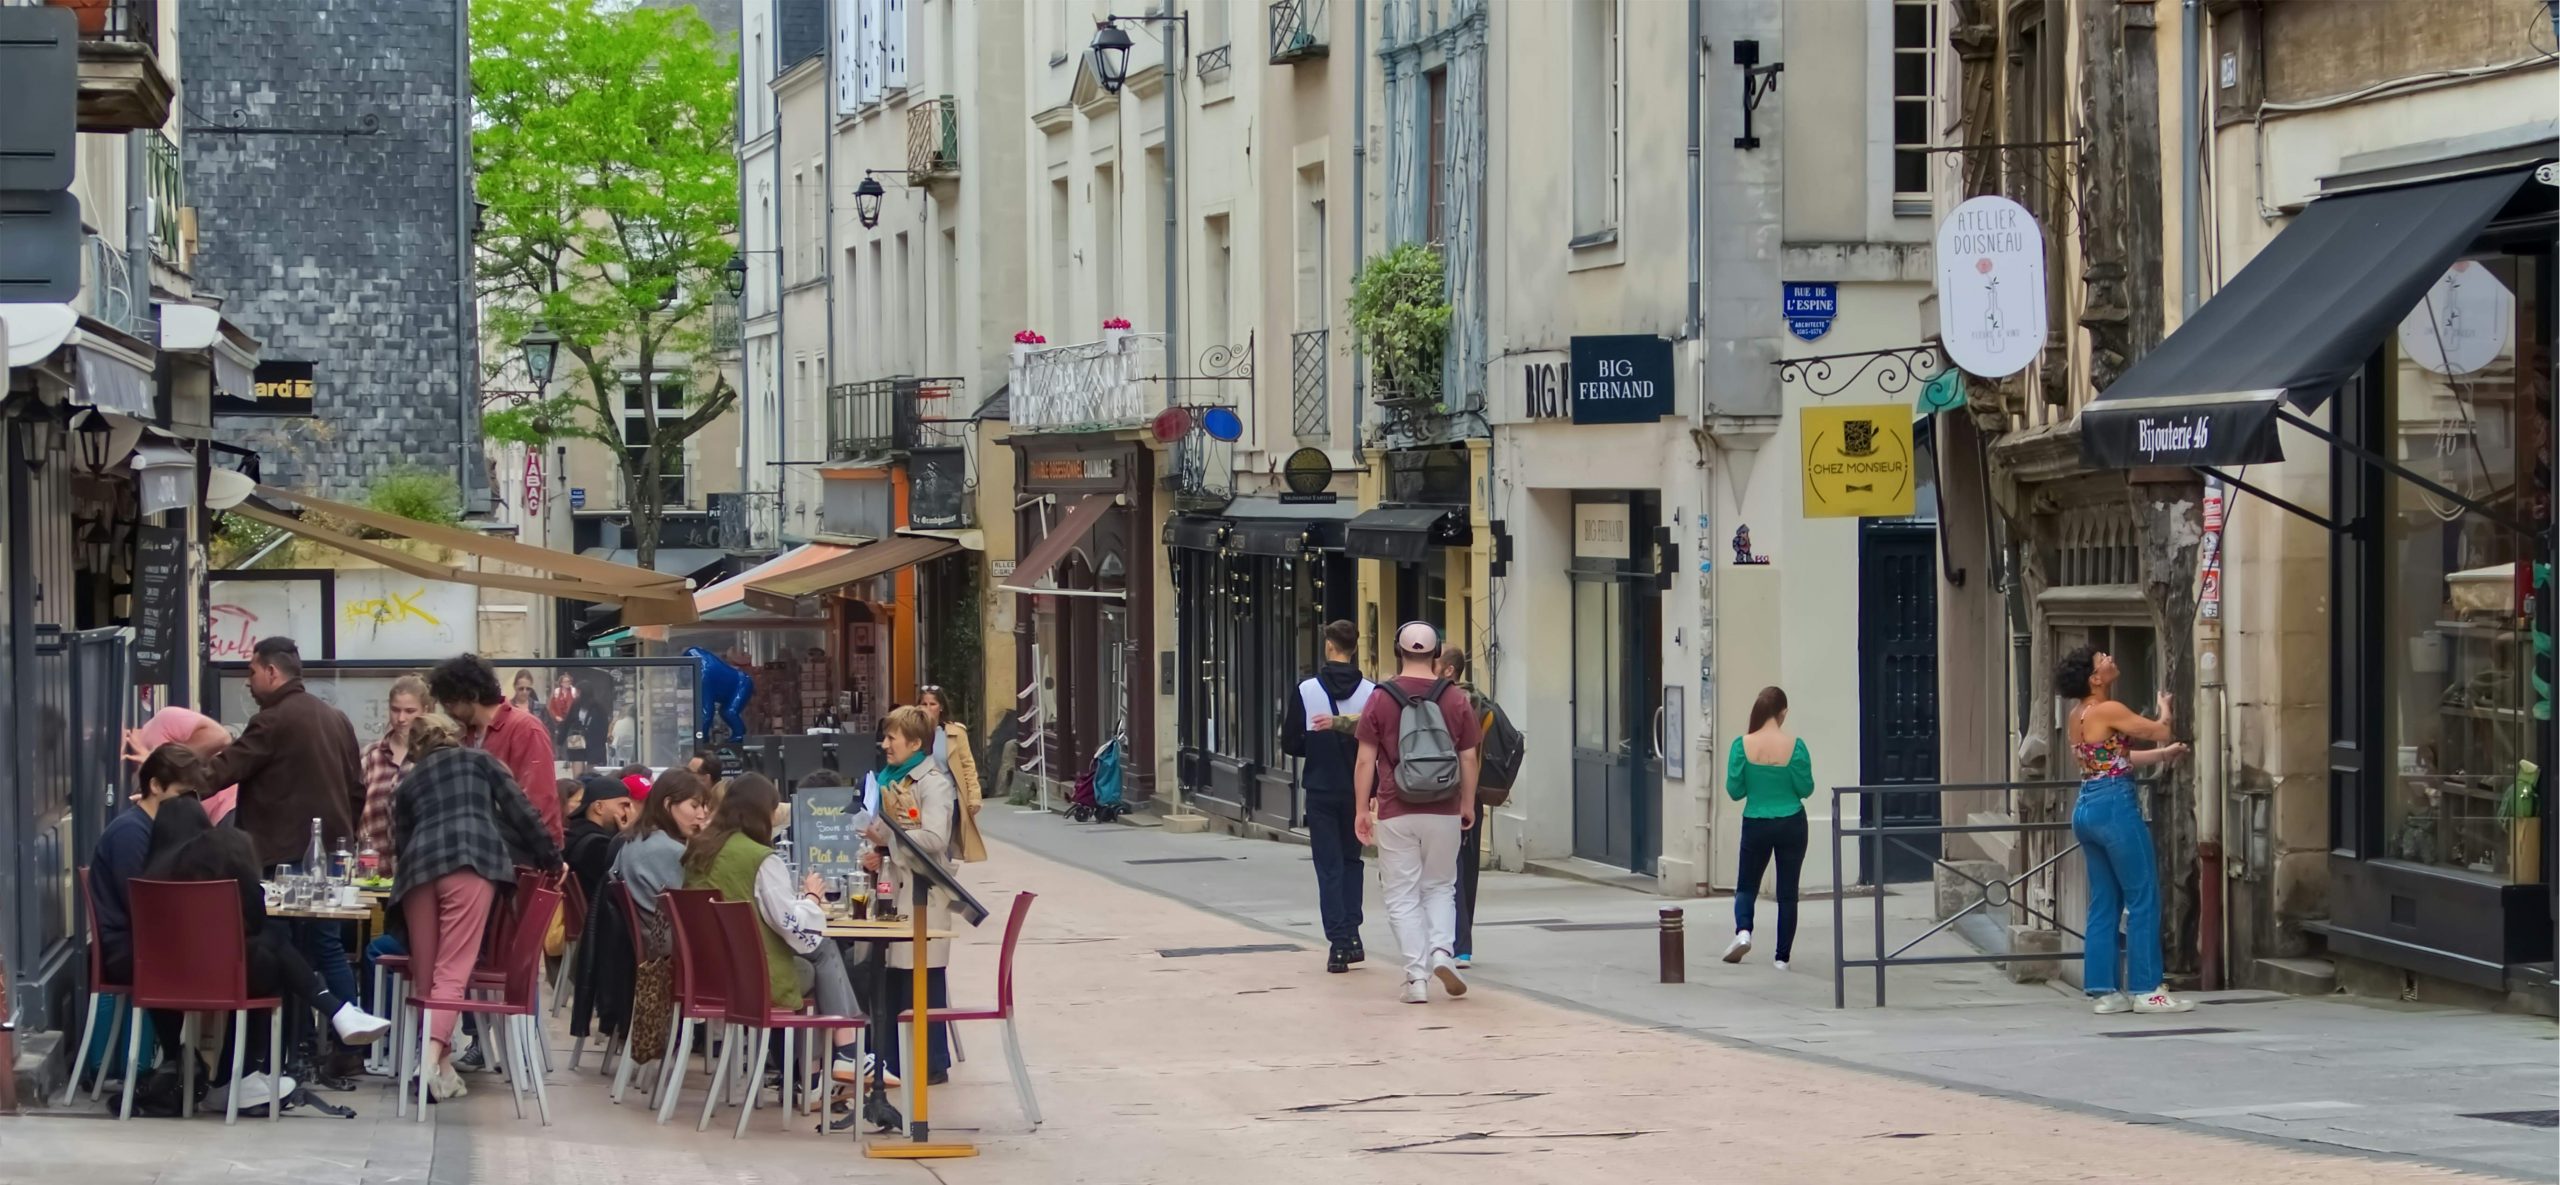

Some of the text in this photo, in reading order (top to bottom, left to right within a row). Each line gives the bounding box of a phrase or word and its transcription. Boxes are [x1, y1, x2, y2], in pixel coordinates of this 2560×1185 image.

[1958, 209, 2016, 231] ATELIER
[1954, 232, 2022, 255] DOISNEAU
[1794, 287, 1827, 297] RUE DE
[1787, 299, 1834, 311] L'ESPINE
[1599, 359, 1634, 378] BIG
[1524, 362, 1558, 419] BIG
[1579, 380, 1655, 400] FERNAND
[2138, 415, 2210, 463] Bijouterie 46
[1813, 461, 1903, 475] CHEZ MONSIEUR
[526, 452, 541, 511] TABAC
[809, 846, 850, 863] Plat du
